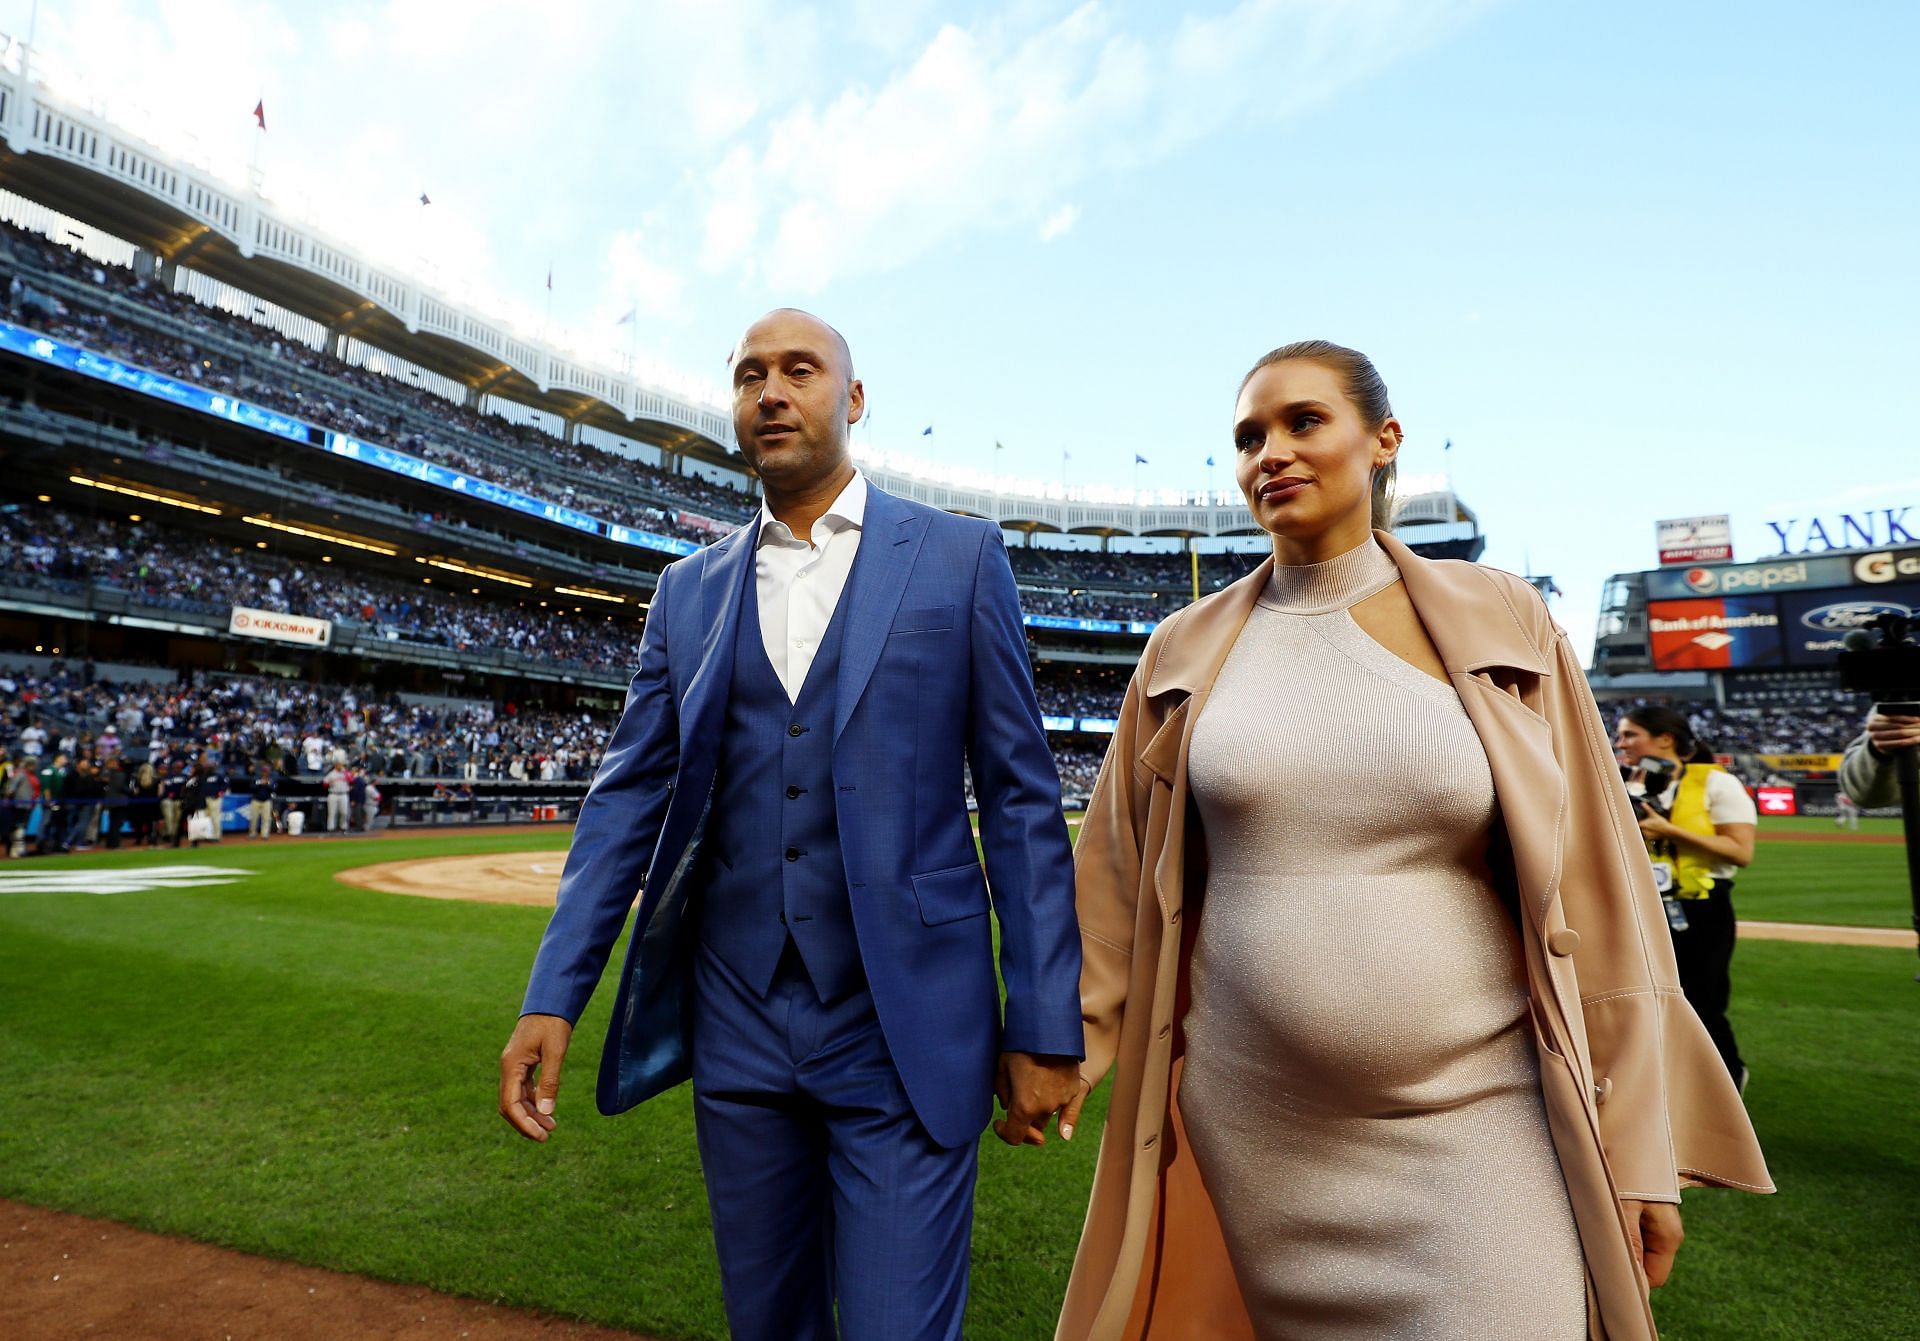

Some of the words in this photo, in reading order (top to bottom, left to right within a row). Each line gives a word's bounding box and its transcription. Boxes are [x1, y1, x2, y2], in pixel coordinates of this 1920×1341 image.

[1766, 507, 1920, 554] YANK
[1721, 562, 1807, 592] pepsi
[254, 618, 315, 635] KIKKOMAN
[1650, 617, 1691, 632] Bank
[1692, 615, 1709, 630] of
[1710, 612, 1778, 629] America
